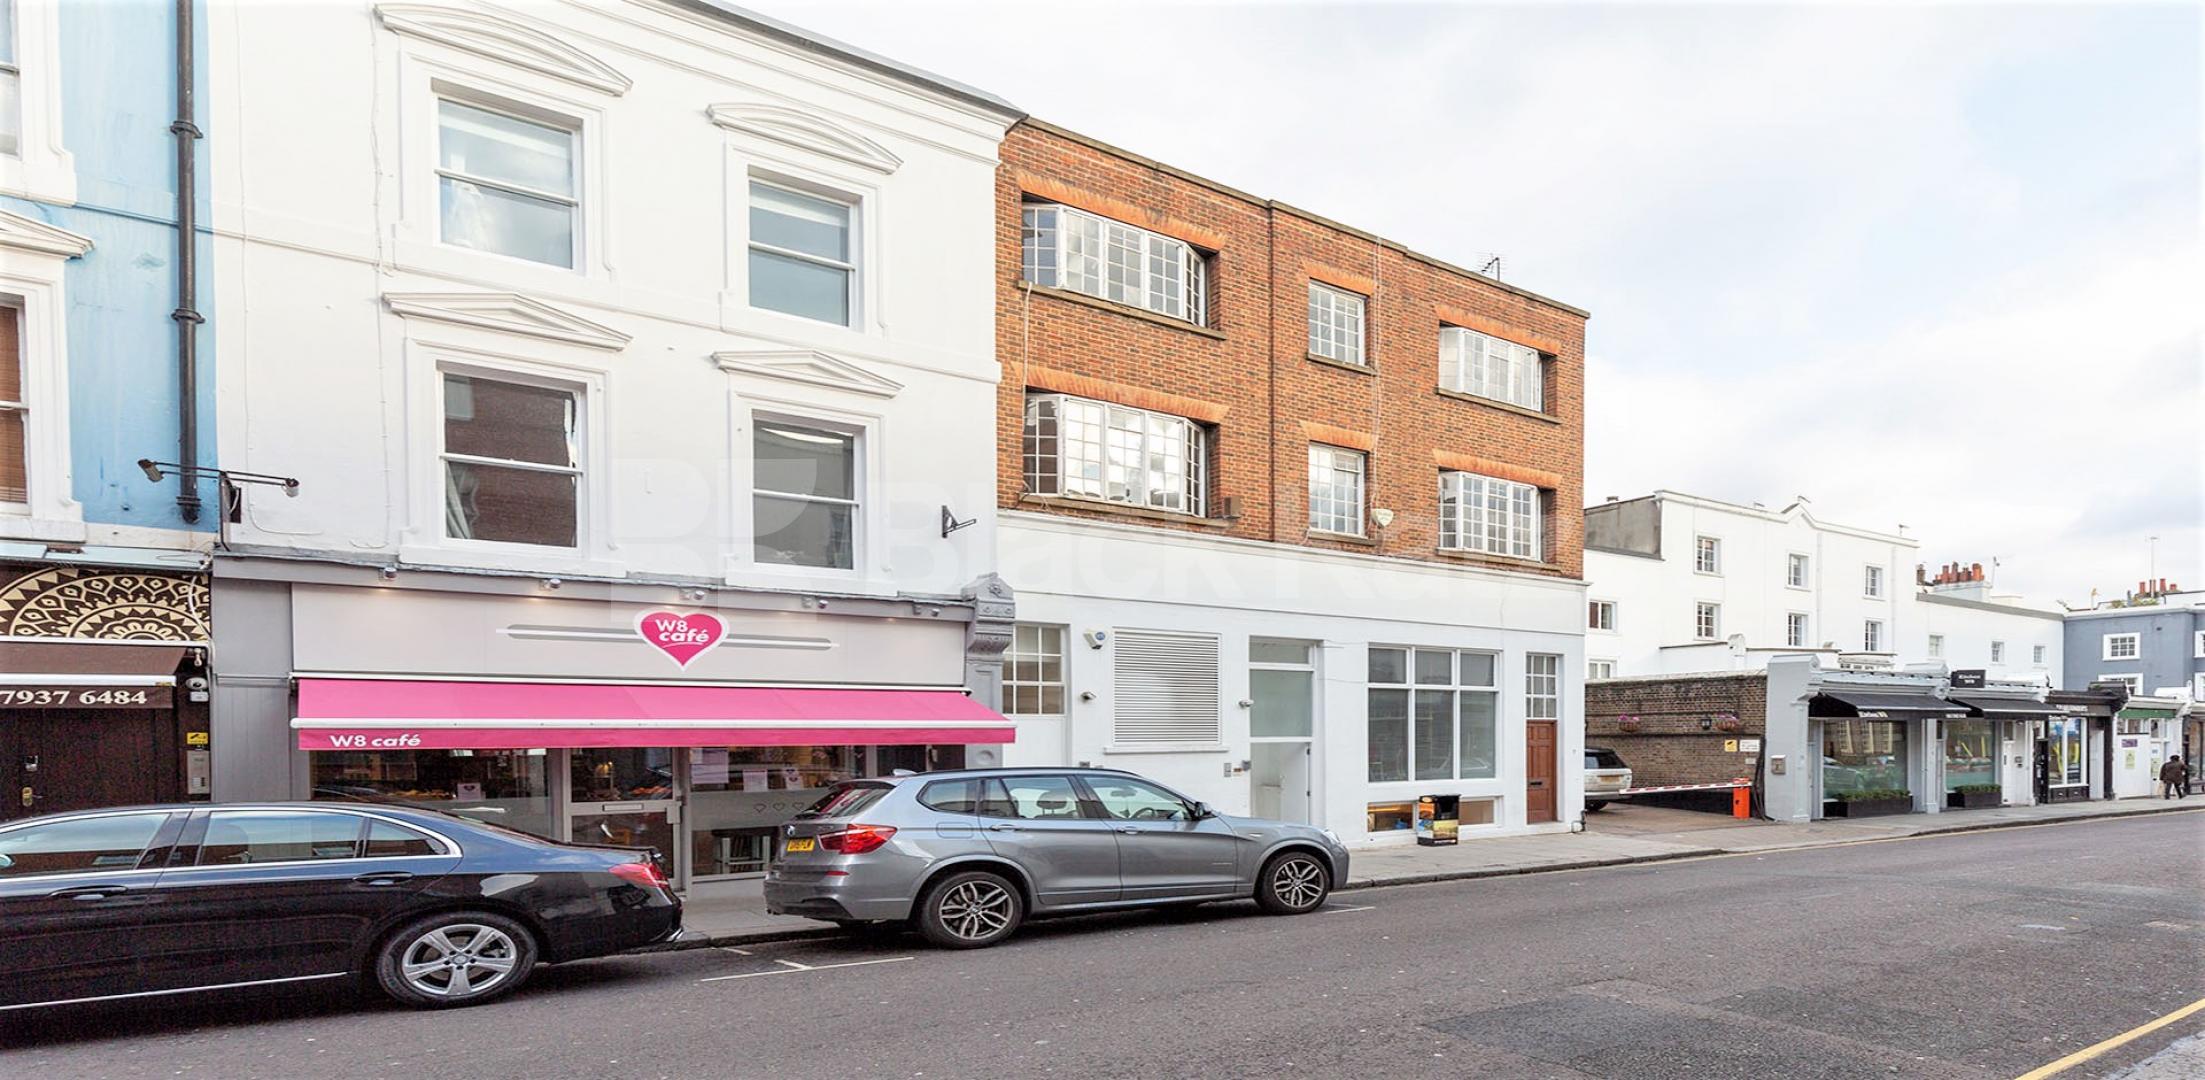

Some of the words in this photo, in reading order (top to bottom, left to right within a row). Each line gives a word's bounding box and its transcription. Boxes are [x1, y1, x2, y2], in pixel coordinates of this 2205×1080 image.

[655, 619, 689, 633] W8
[658, 628, 710, 642] café
[0, 689, 71, 705] 7937
[78, 689, 148, 705] 6484
[329, 734, 367, 748] W8
[371, 733, 422, 748] café
